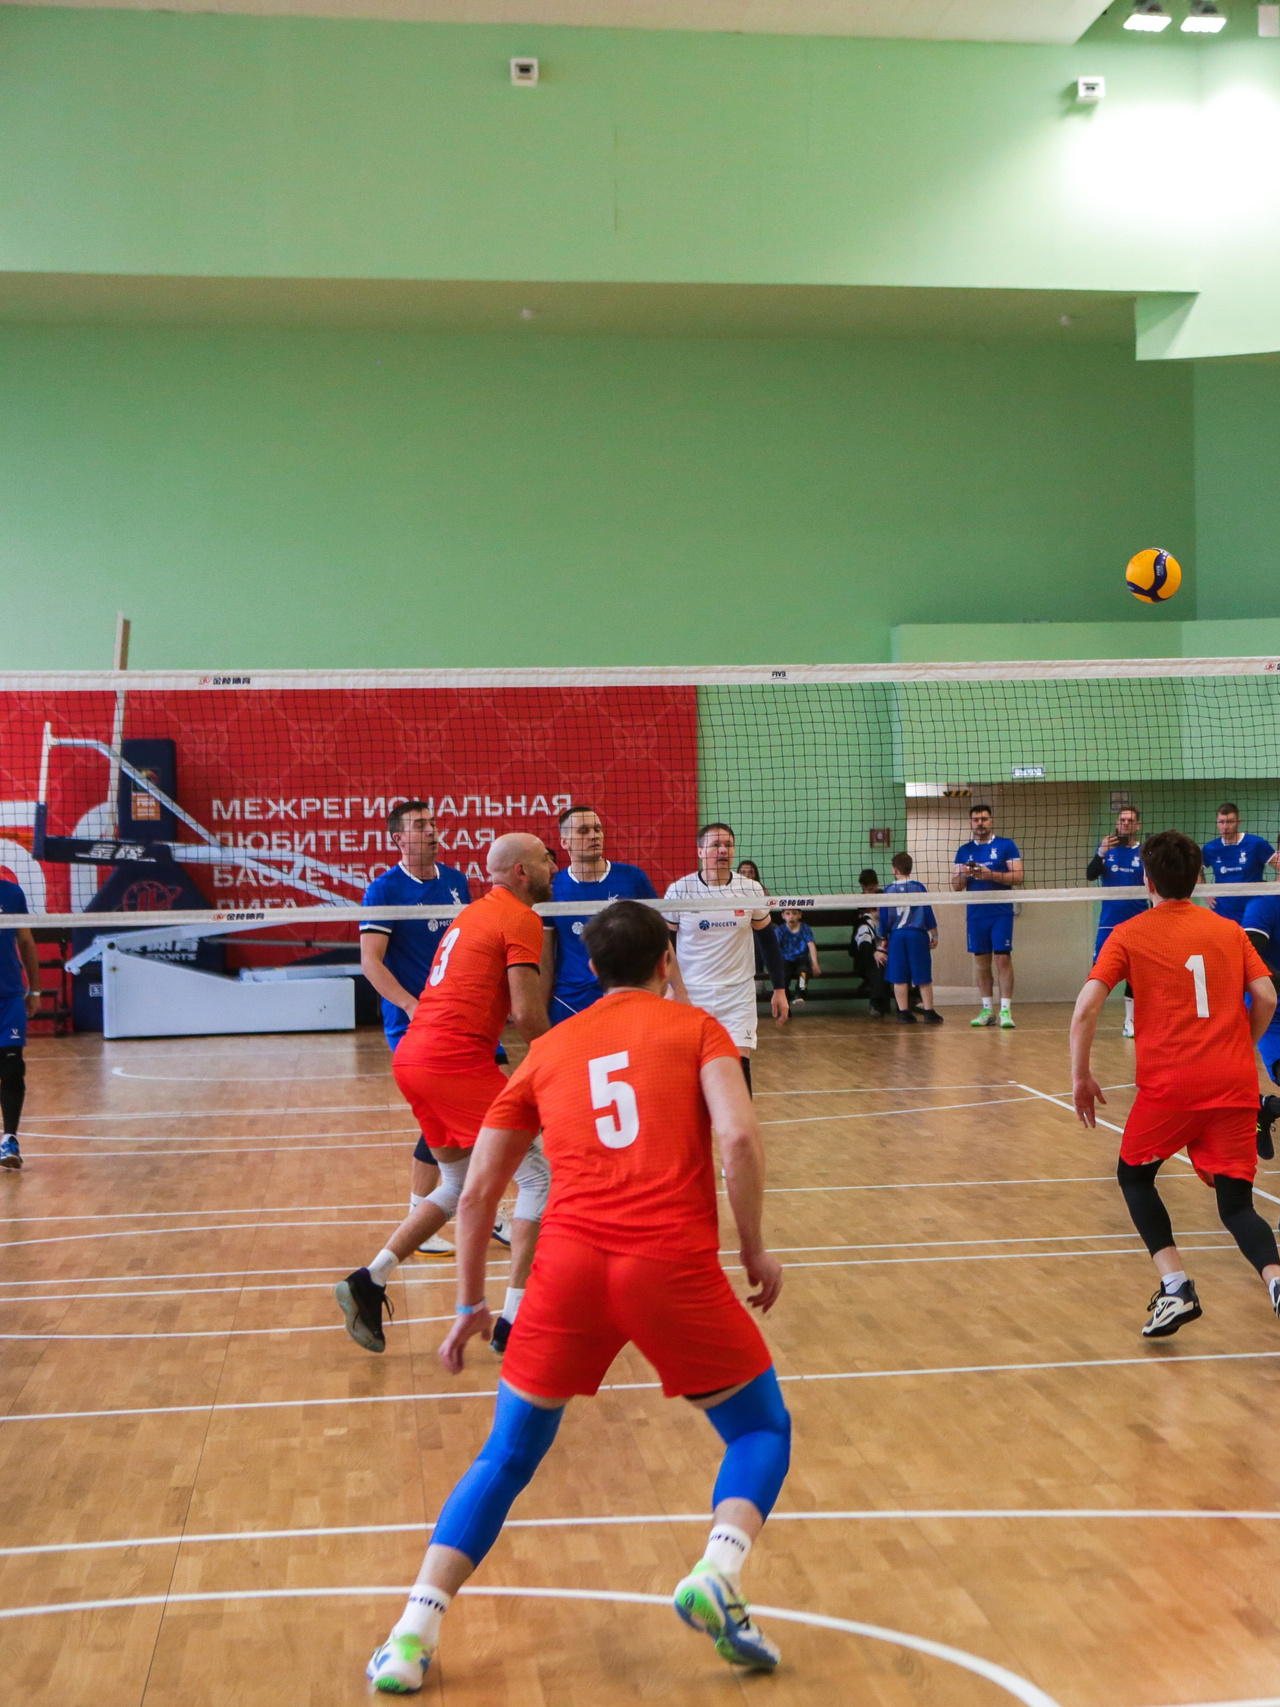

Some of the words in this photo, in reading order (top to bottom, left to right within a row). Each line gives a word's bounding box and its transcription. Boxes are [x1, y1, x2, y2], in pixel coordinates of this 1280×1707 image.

[214, 828, 496, 852] ЛЮБИТЕЛЬКАЯ
[429, 928, 460, 987] 3
[1184, 954, 1210, 1018] 1
[588, 1050, 639, 1149] 5
